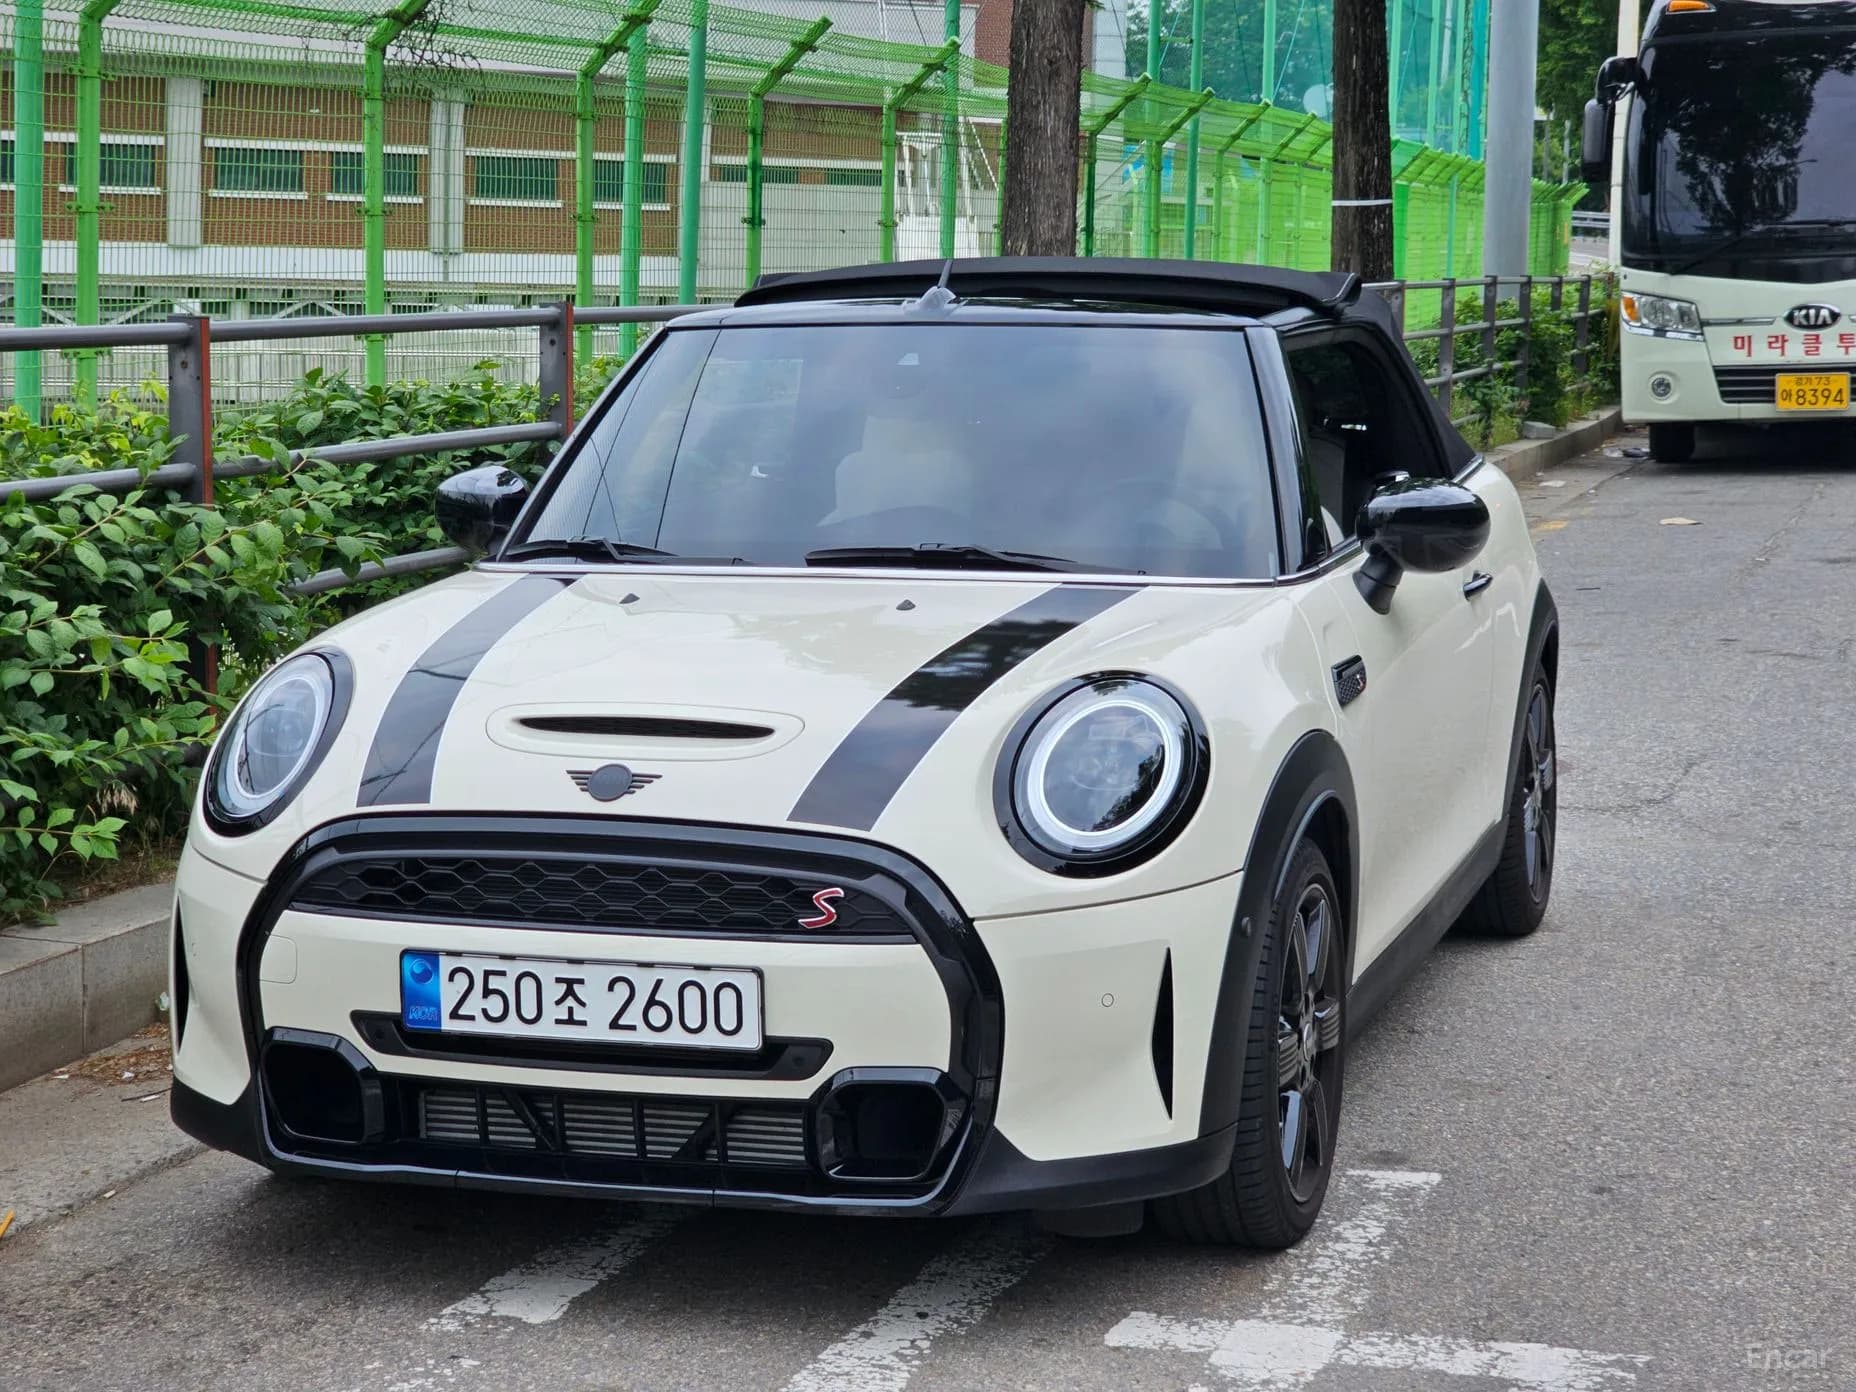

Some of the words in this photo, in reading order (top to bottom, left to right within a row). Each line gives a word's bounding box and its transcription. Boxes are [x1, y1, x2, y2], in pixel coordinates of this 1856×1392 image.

[1792, 308, 1833, 326] KIA
[1814, 376, 1831, 386] 73
[798, 887, 845, 929] S
[447, 966, 588, 1027] 250조
[606, 975, 744, 1037] 2600
